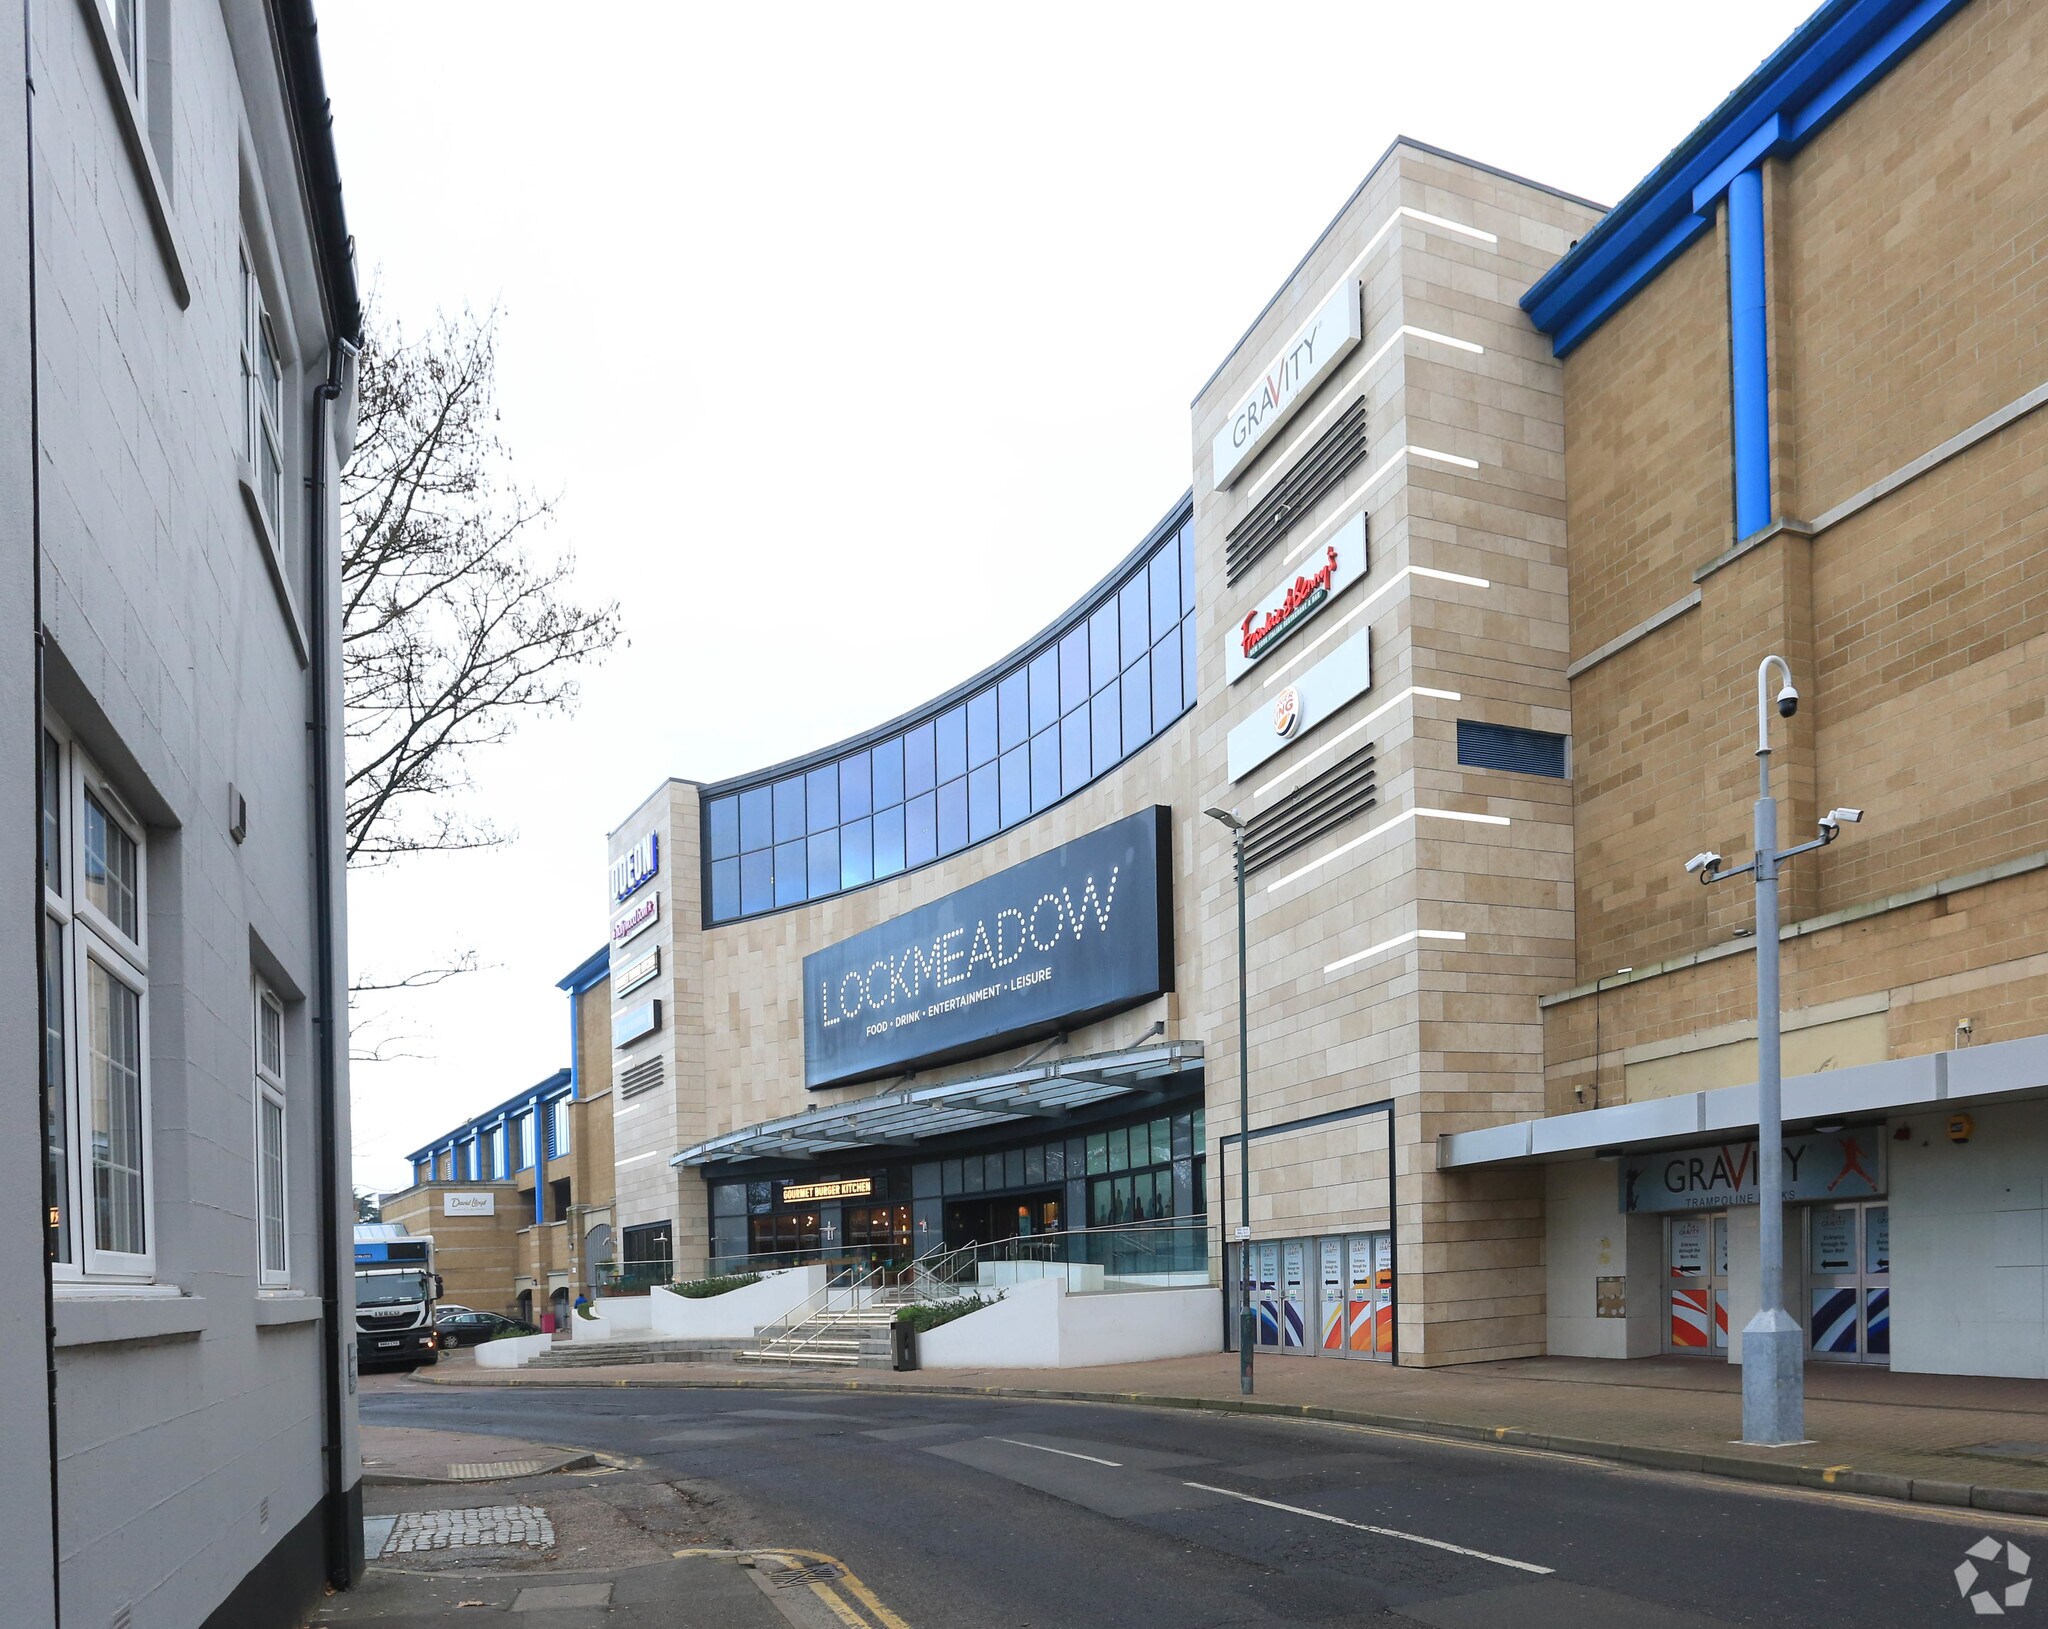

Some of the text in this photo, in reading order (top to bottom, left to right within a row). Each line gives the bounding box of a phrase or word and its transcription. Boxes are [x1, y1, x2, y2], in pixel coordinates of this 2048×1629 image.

[1233, 325, 1318, 449] GRAVITY
[1241, 609, 1284, 659] Frankie
[1293, 546, 1338, 607] Benny's
[612, 832, 656, 901] ODEON
[823, 865, 1119, 1027] LOCKMEADOW
[866, 966, 1052, 1037] FOOD DRINK ENTERTAINMENT LEISURE
[783, 1181, 871, 1200] GOURMET BURGER KITCHEN
[1664, 1142, 1807, 1193] GRAVIY
[1686, 1193, 1754, 1208] TRAMPOLINE
[451, 1197, 488, 1208] David Lloyd
